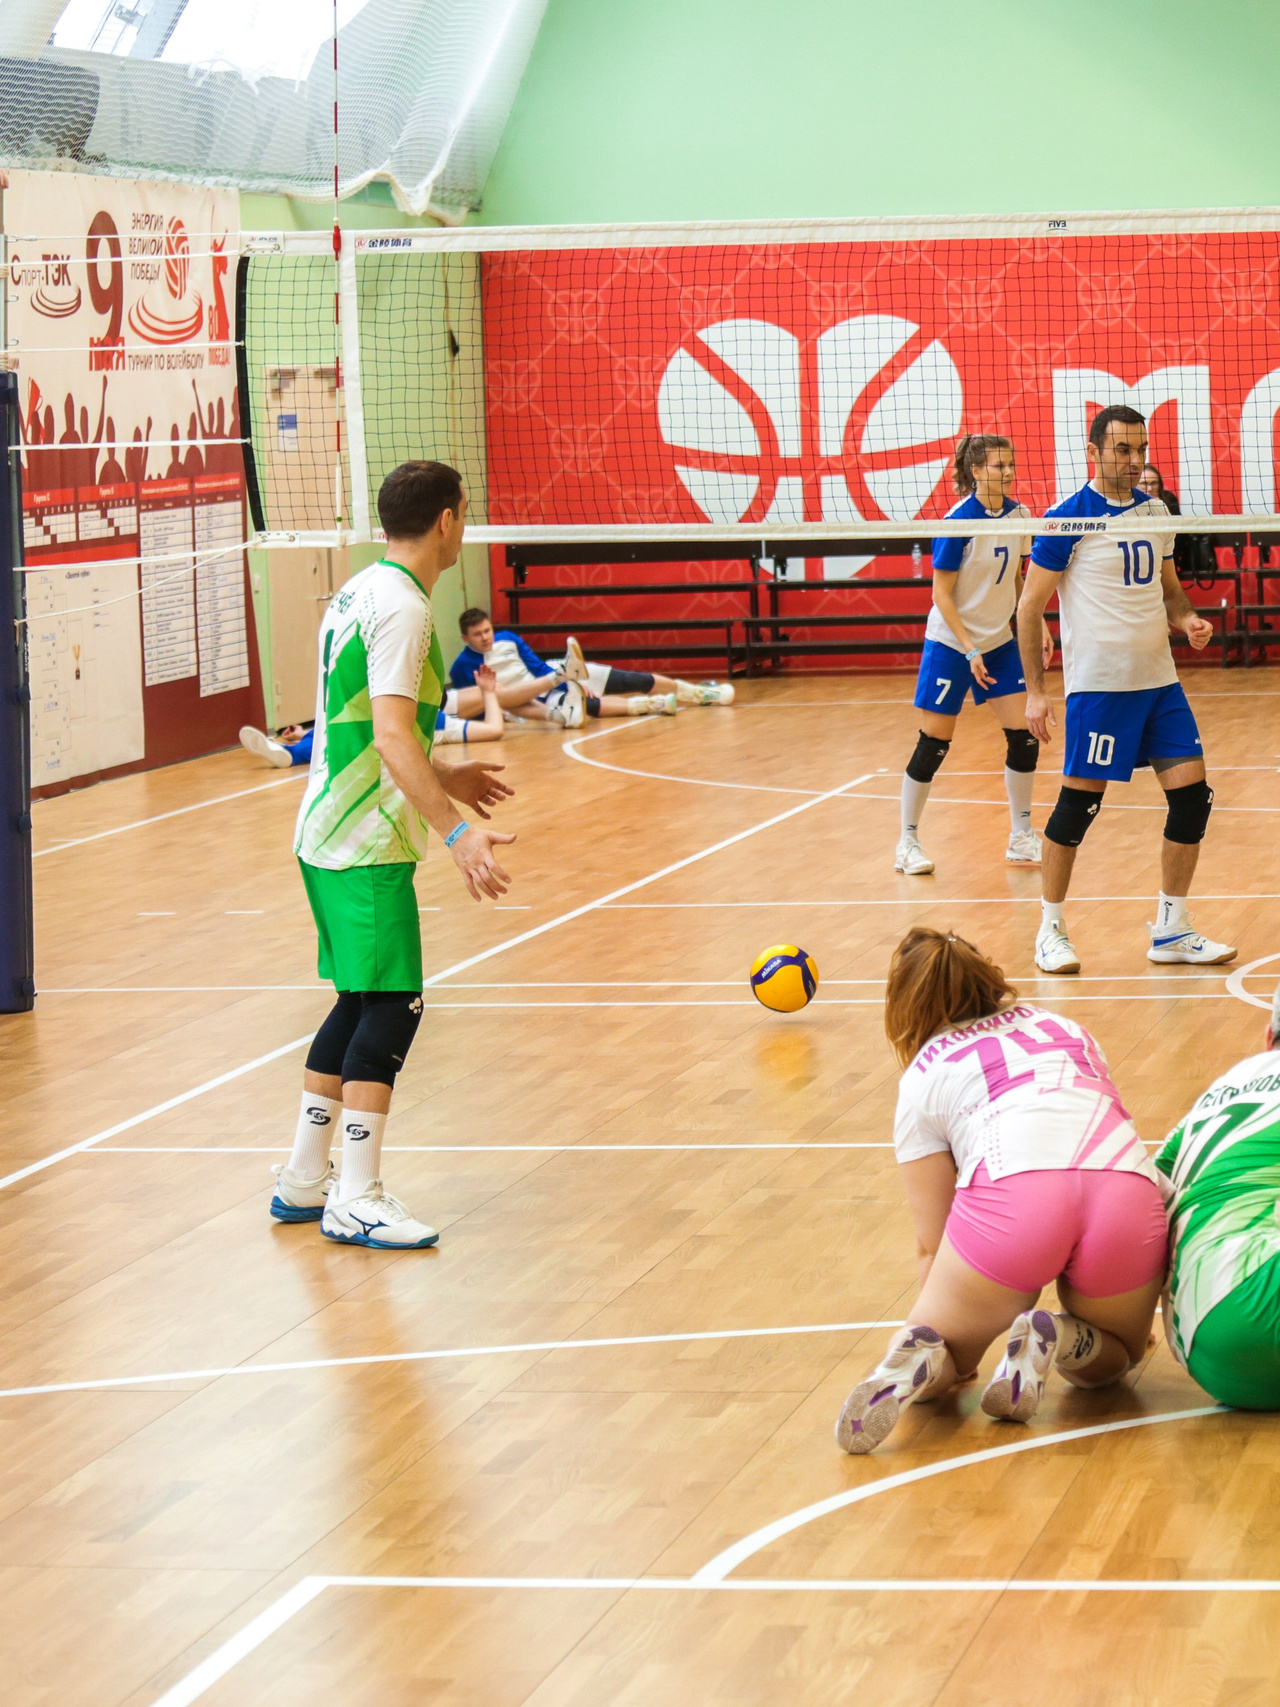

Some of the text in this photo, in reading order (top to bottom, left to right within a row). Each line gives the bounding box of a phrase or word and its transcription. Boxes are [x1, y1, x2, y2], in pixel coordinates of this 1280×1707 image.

[131, 213, 164, 231] ЭНЕРГИЯ
[1048, 220, 1067, 228] FIVB
[129, 236, 163, 255] ВЕЛИКОЙ
[85, 210, 123, 345] 9
[131, 262, 161, 284] ПОБЕДЫ
[128, 350, 204, 371] ТУРНИР ПО ВОЛЕЙБОЛУ
[994, 546, 1009, 585] 7
[1117, 539, 1154, 587] 10
[936, 678, 951, 705] 7
[1086, 731, 1116, 766] 10
[943, 1018, 1099, 1103] 24
